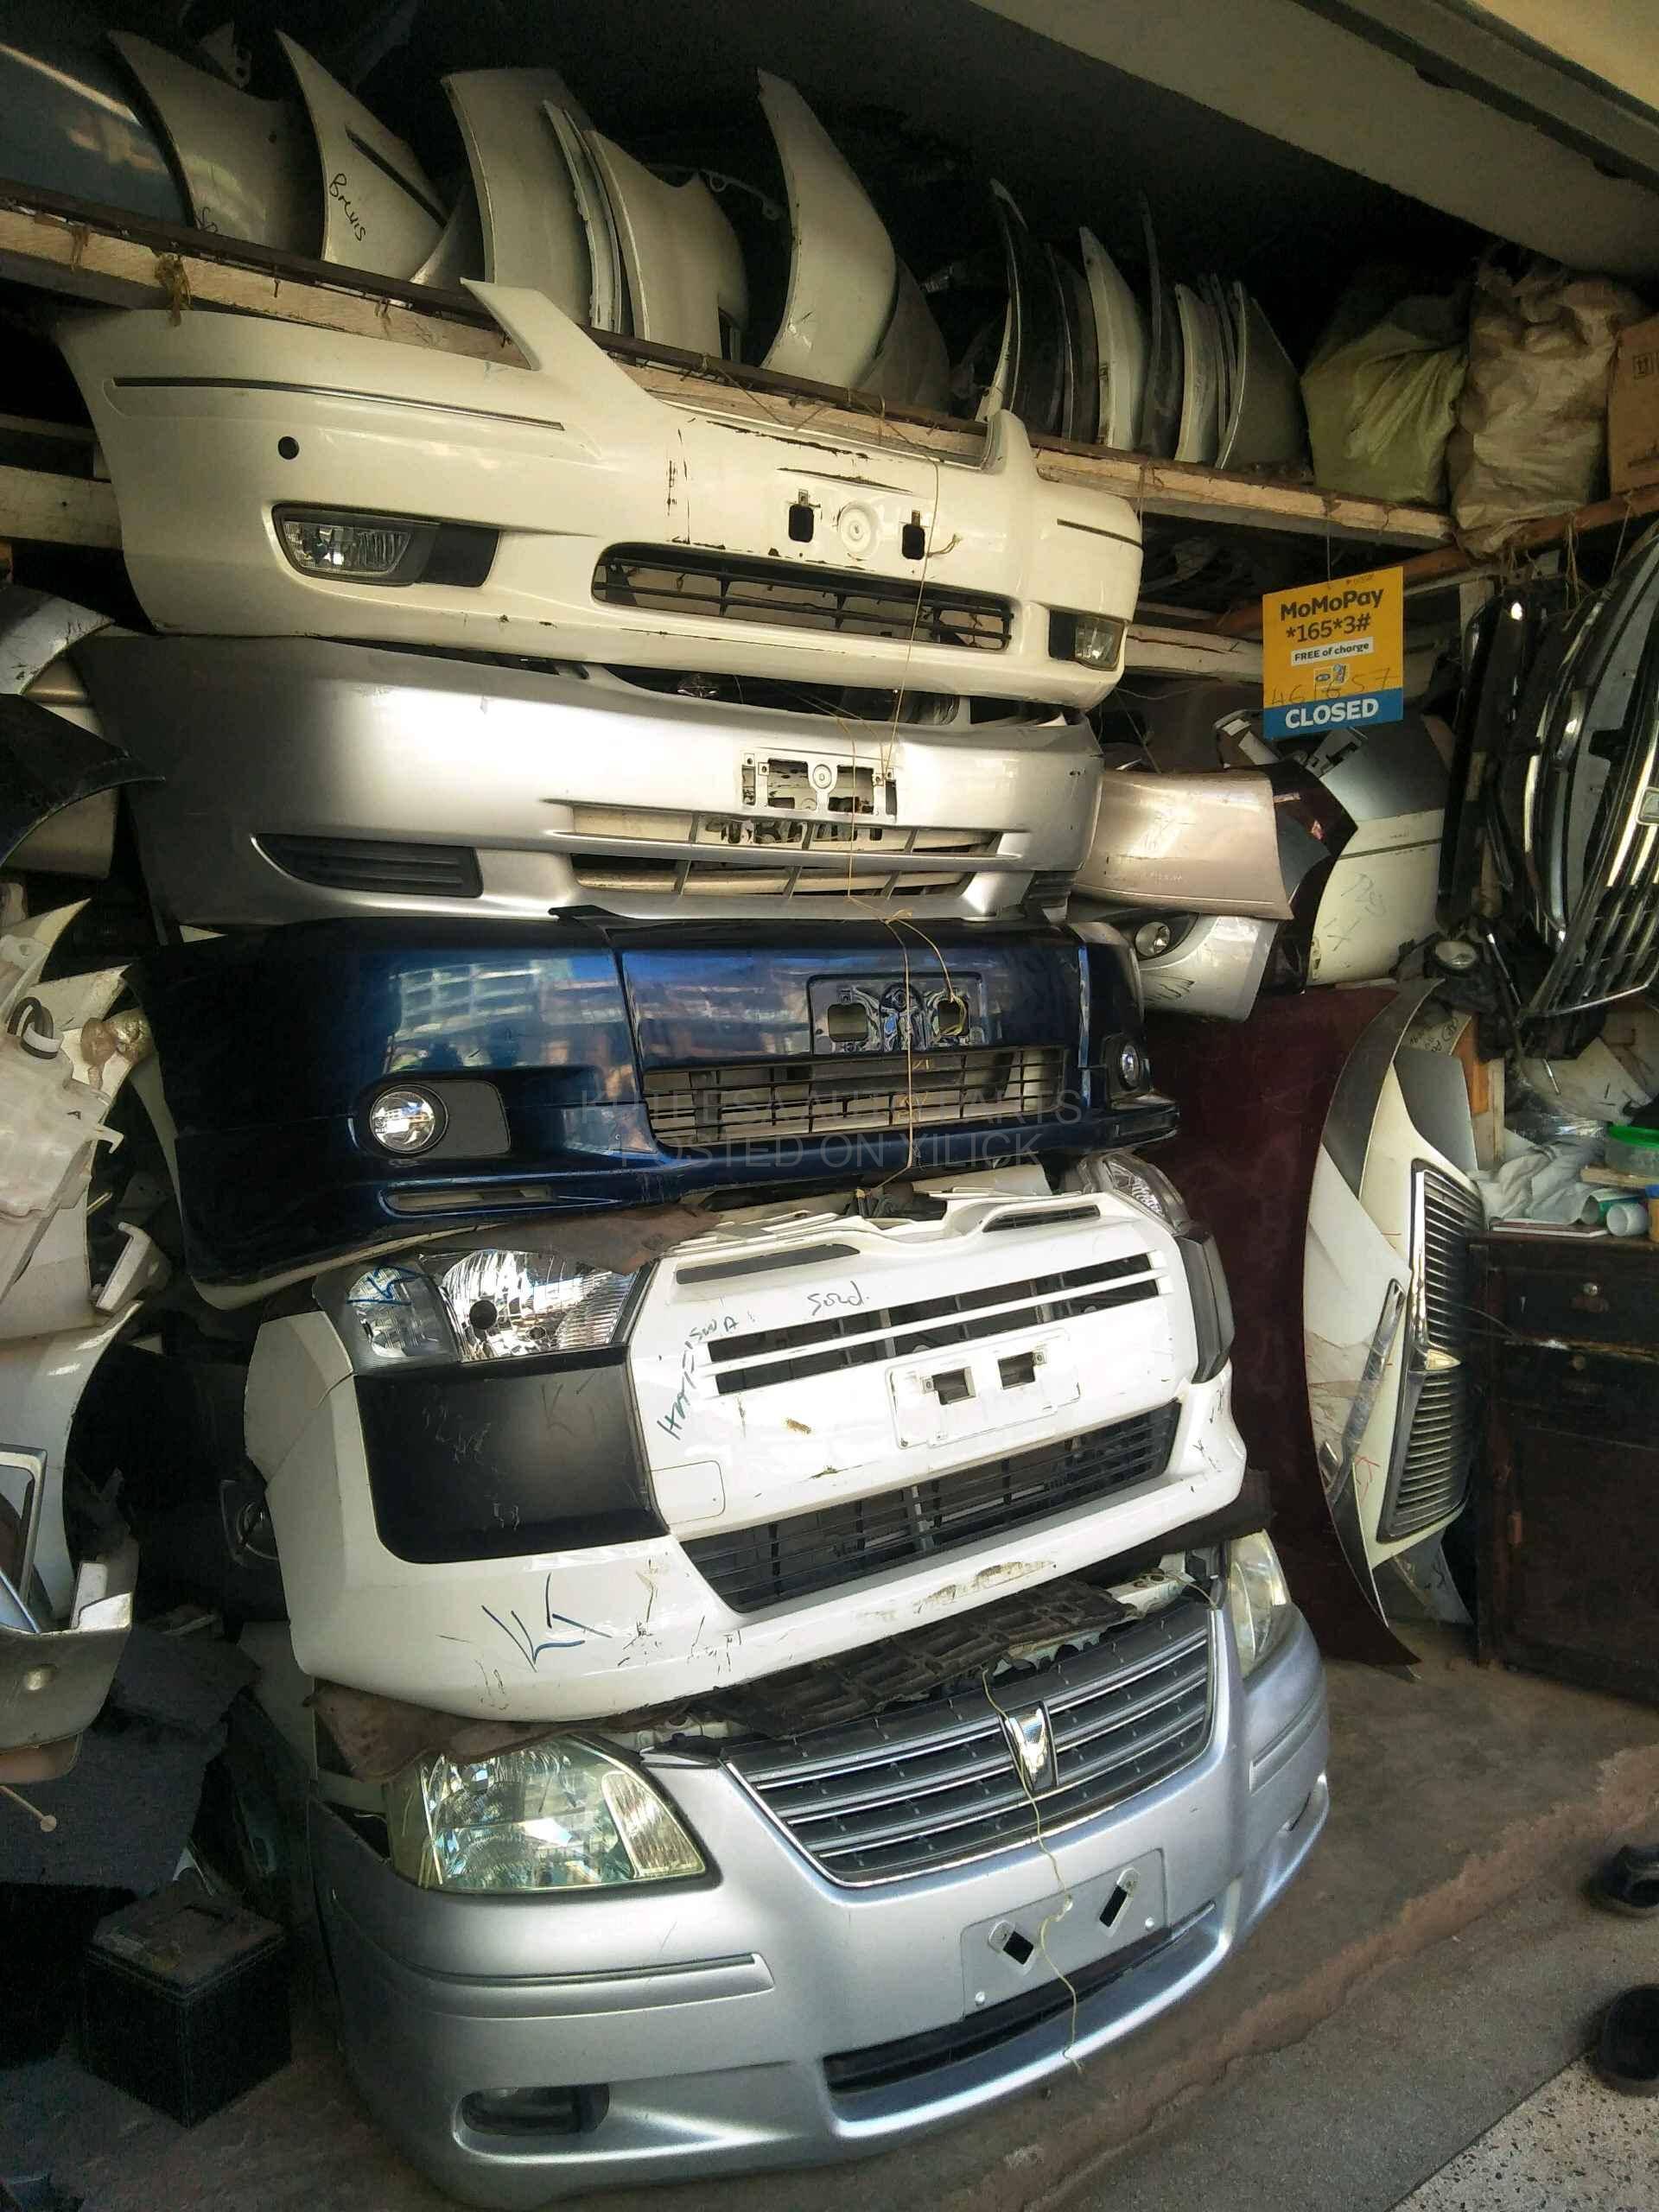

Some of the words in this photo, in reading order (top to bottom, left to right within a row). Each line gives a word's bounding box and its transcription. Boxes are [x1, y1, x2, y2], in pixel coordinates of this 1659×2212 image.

[1281, 589, 1384, 620] MoMoPay
[1294, 650, 1320, 662] FREE
[1322, 647, 1333, 657] of
[1335, 642, 1370, 653] charge
[1285, 698, 1379, 729] CLOSED
